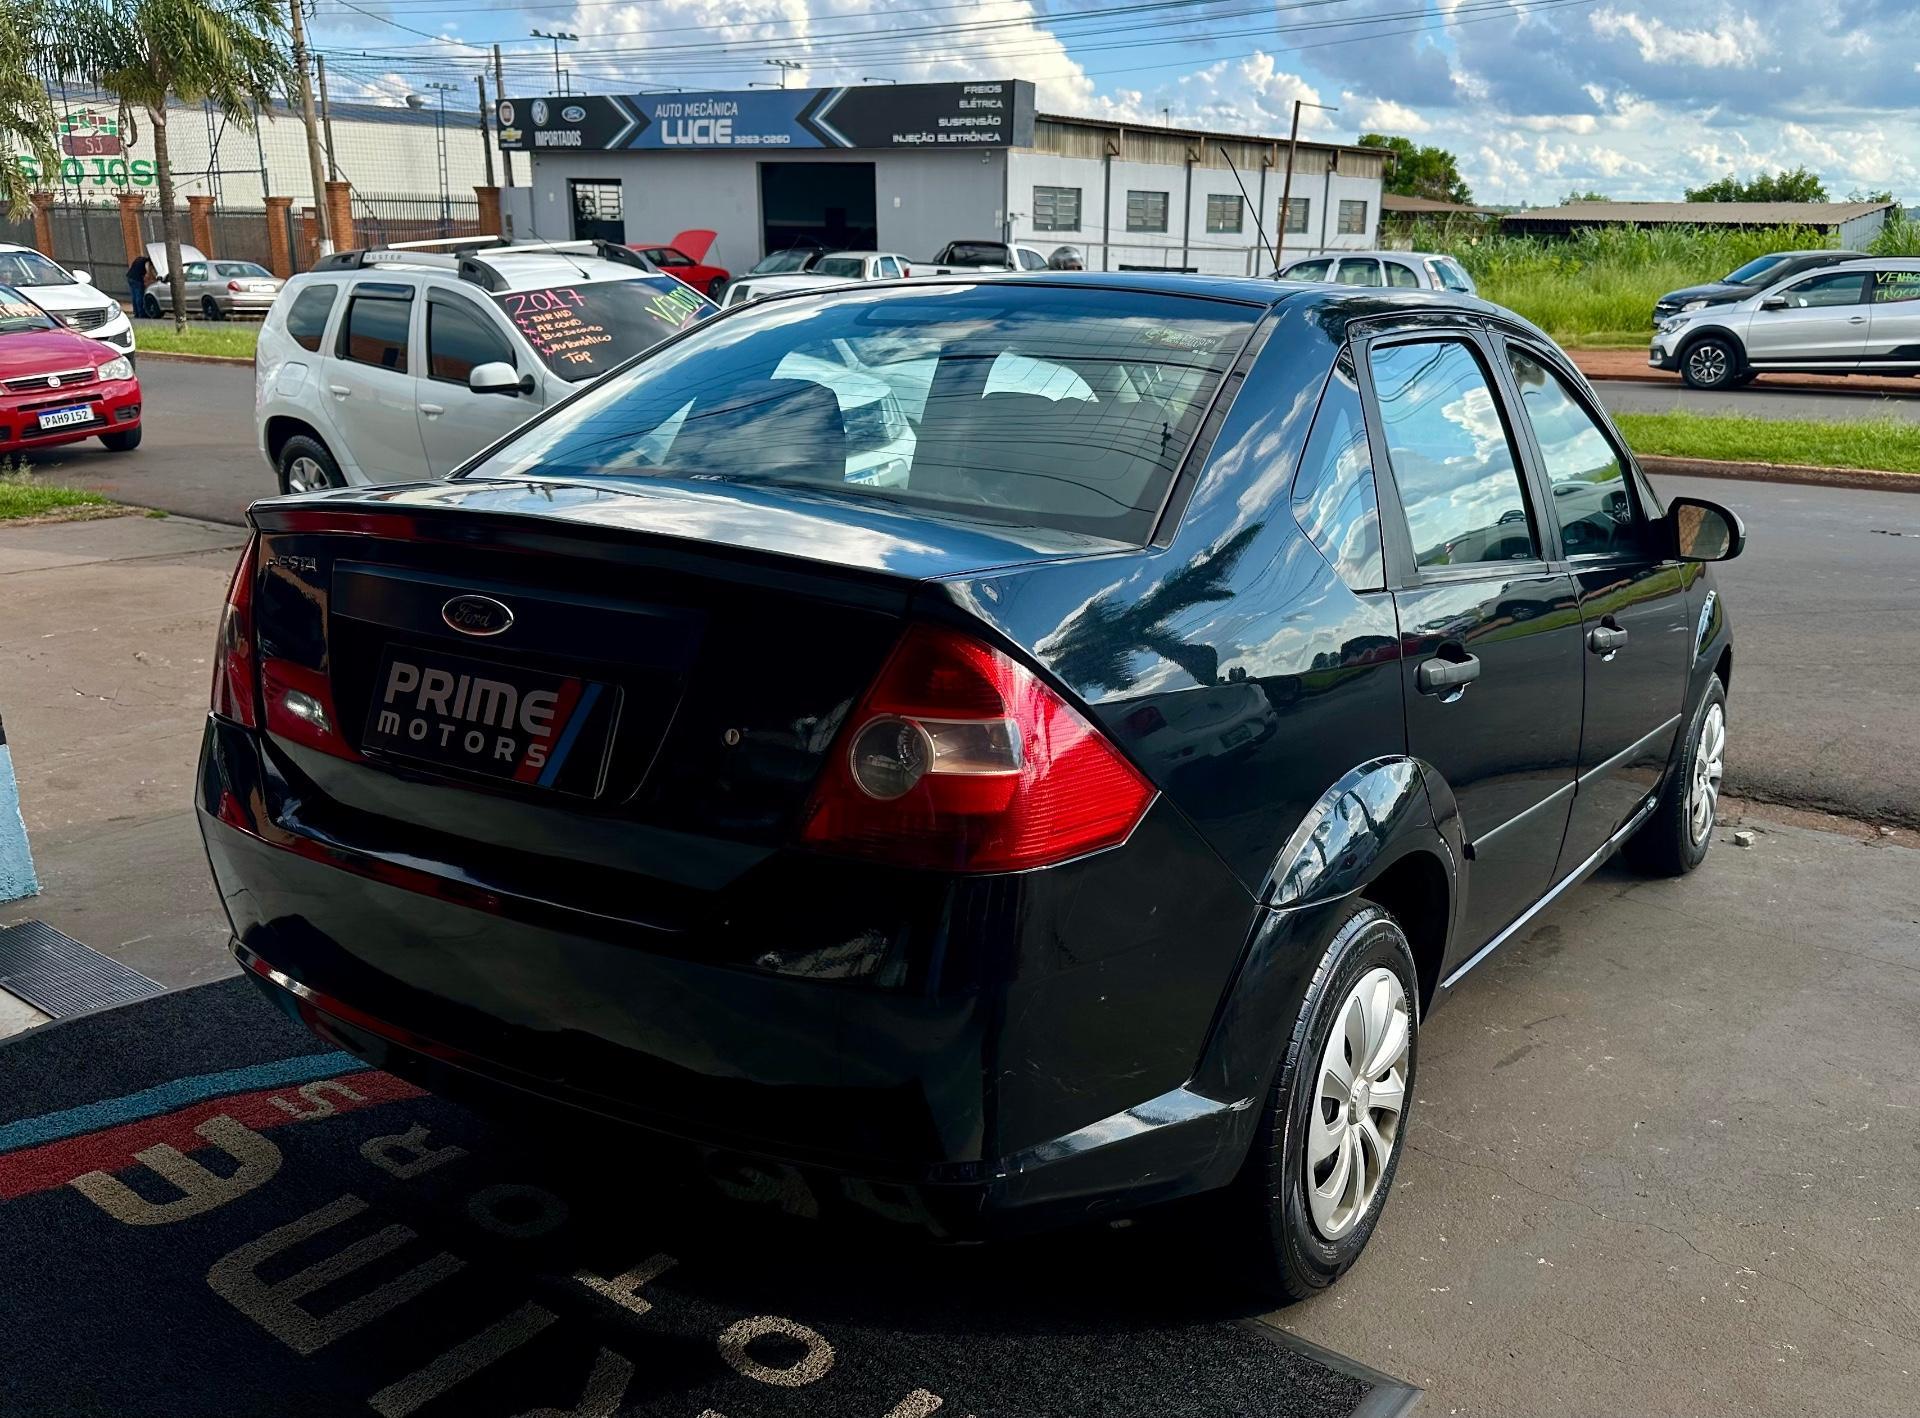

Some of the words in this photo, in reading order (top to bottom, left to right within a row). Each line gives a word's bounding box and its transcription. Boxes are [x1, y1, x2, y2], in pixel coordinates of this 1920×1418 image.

[963, 85, 1002, 94] FREIOS
[655, 103, 682, 118] AUTO
[684, 98, 739, 117] MECÂNICA
[958, 98, 1003, 109] ELÉTRICA
[938, 115, 1001, 127] SUSPENSÃO
[534, 130, 582, 147] IMPORTADOS
[661, 118, 733, 145] LUCIE
[892, 131, 935, 144] INJEÇÃO
[937, 131, 1001, 142] ELETRÔNICA
[85, 137, 104, 154] SJ
[18, 155, 85, 185] SO
[505, 289, 586, 316] 2017
[44, 410, 88, 426] PAH9152
[454, 601, 492, 627] Ford
[384, 661, 559, 738] PRIME
[377, 709, 548, 768] MOTORS
